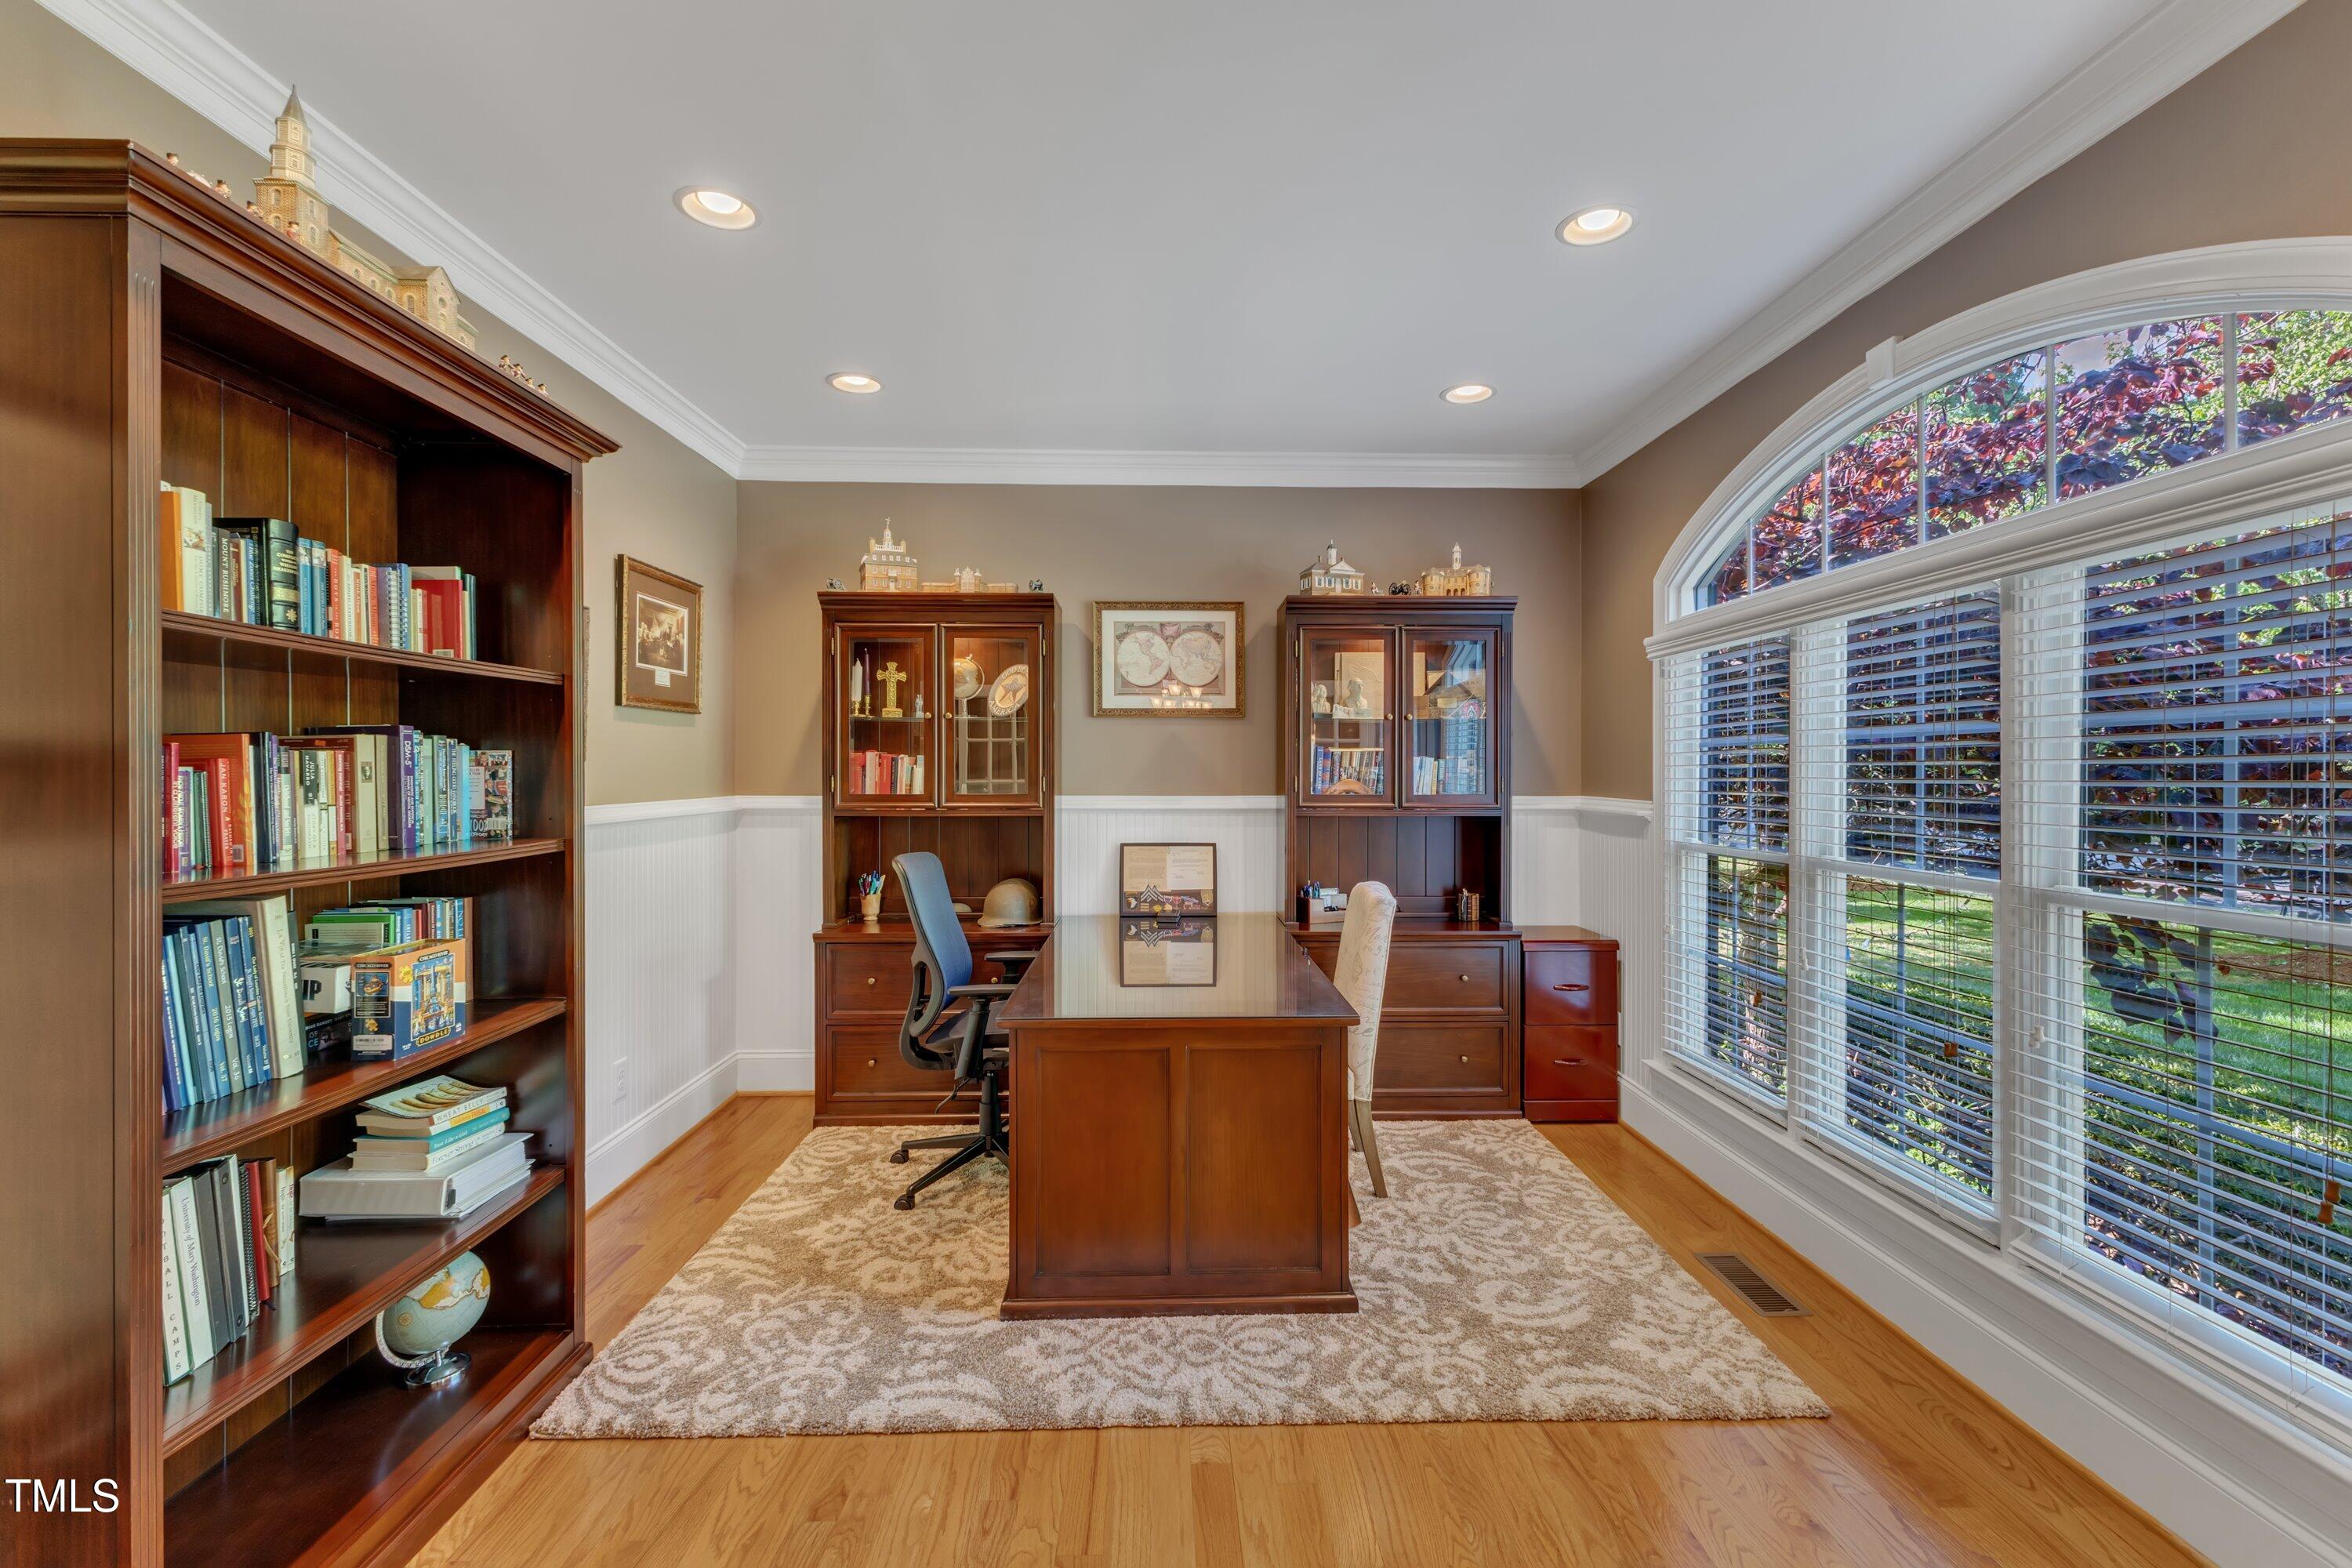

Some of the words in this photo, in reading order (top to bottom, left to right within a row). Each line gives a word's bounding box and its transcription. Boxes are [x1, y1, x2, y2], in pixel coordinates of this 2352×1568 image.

[989, 700, 1019, 715] AMERICA
[203, 946, 212, 966] David's
[216, 946, 226, 966] David's
[419, 953, 437, 962] CHICAGO
[303, 979, 321, 1000] IP
[226, 1022, 234, 1039] Logos
[316, 1018, 332, 1027] RAMSEY
[212, 1024, 221, 1042] Logos
[308, 1036, 320, 1048] CE
[419, 1029, 448, 1044] DOWDLE
[233, 1072, 240, 1080] 36
[436, 1106, 461, 1121] WHEAT
[464, 1099, 483, 1111] BELLY
[432, 1150, 454, 1164] Forever
[181, 1196, 191, 1234] University
[186, 1242, 196, 1263] Mary
[189, 1262, 201, 1306] Washington
[170, 1313, 182, 1370] CAMPS
